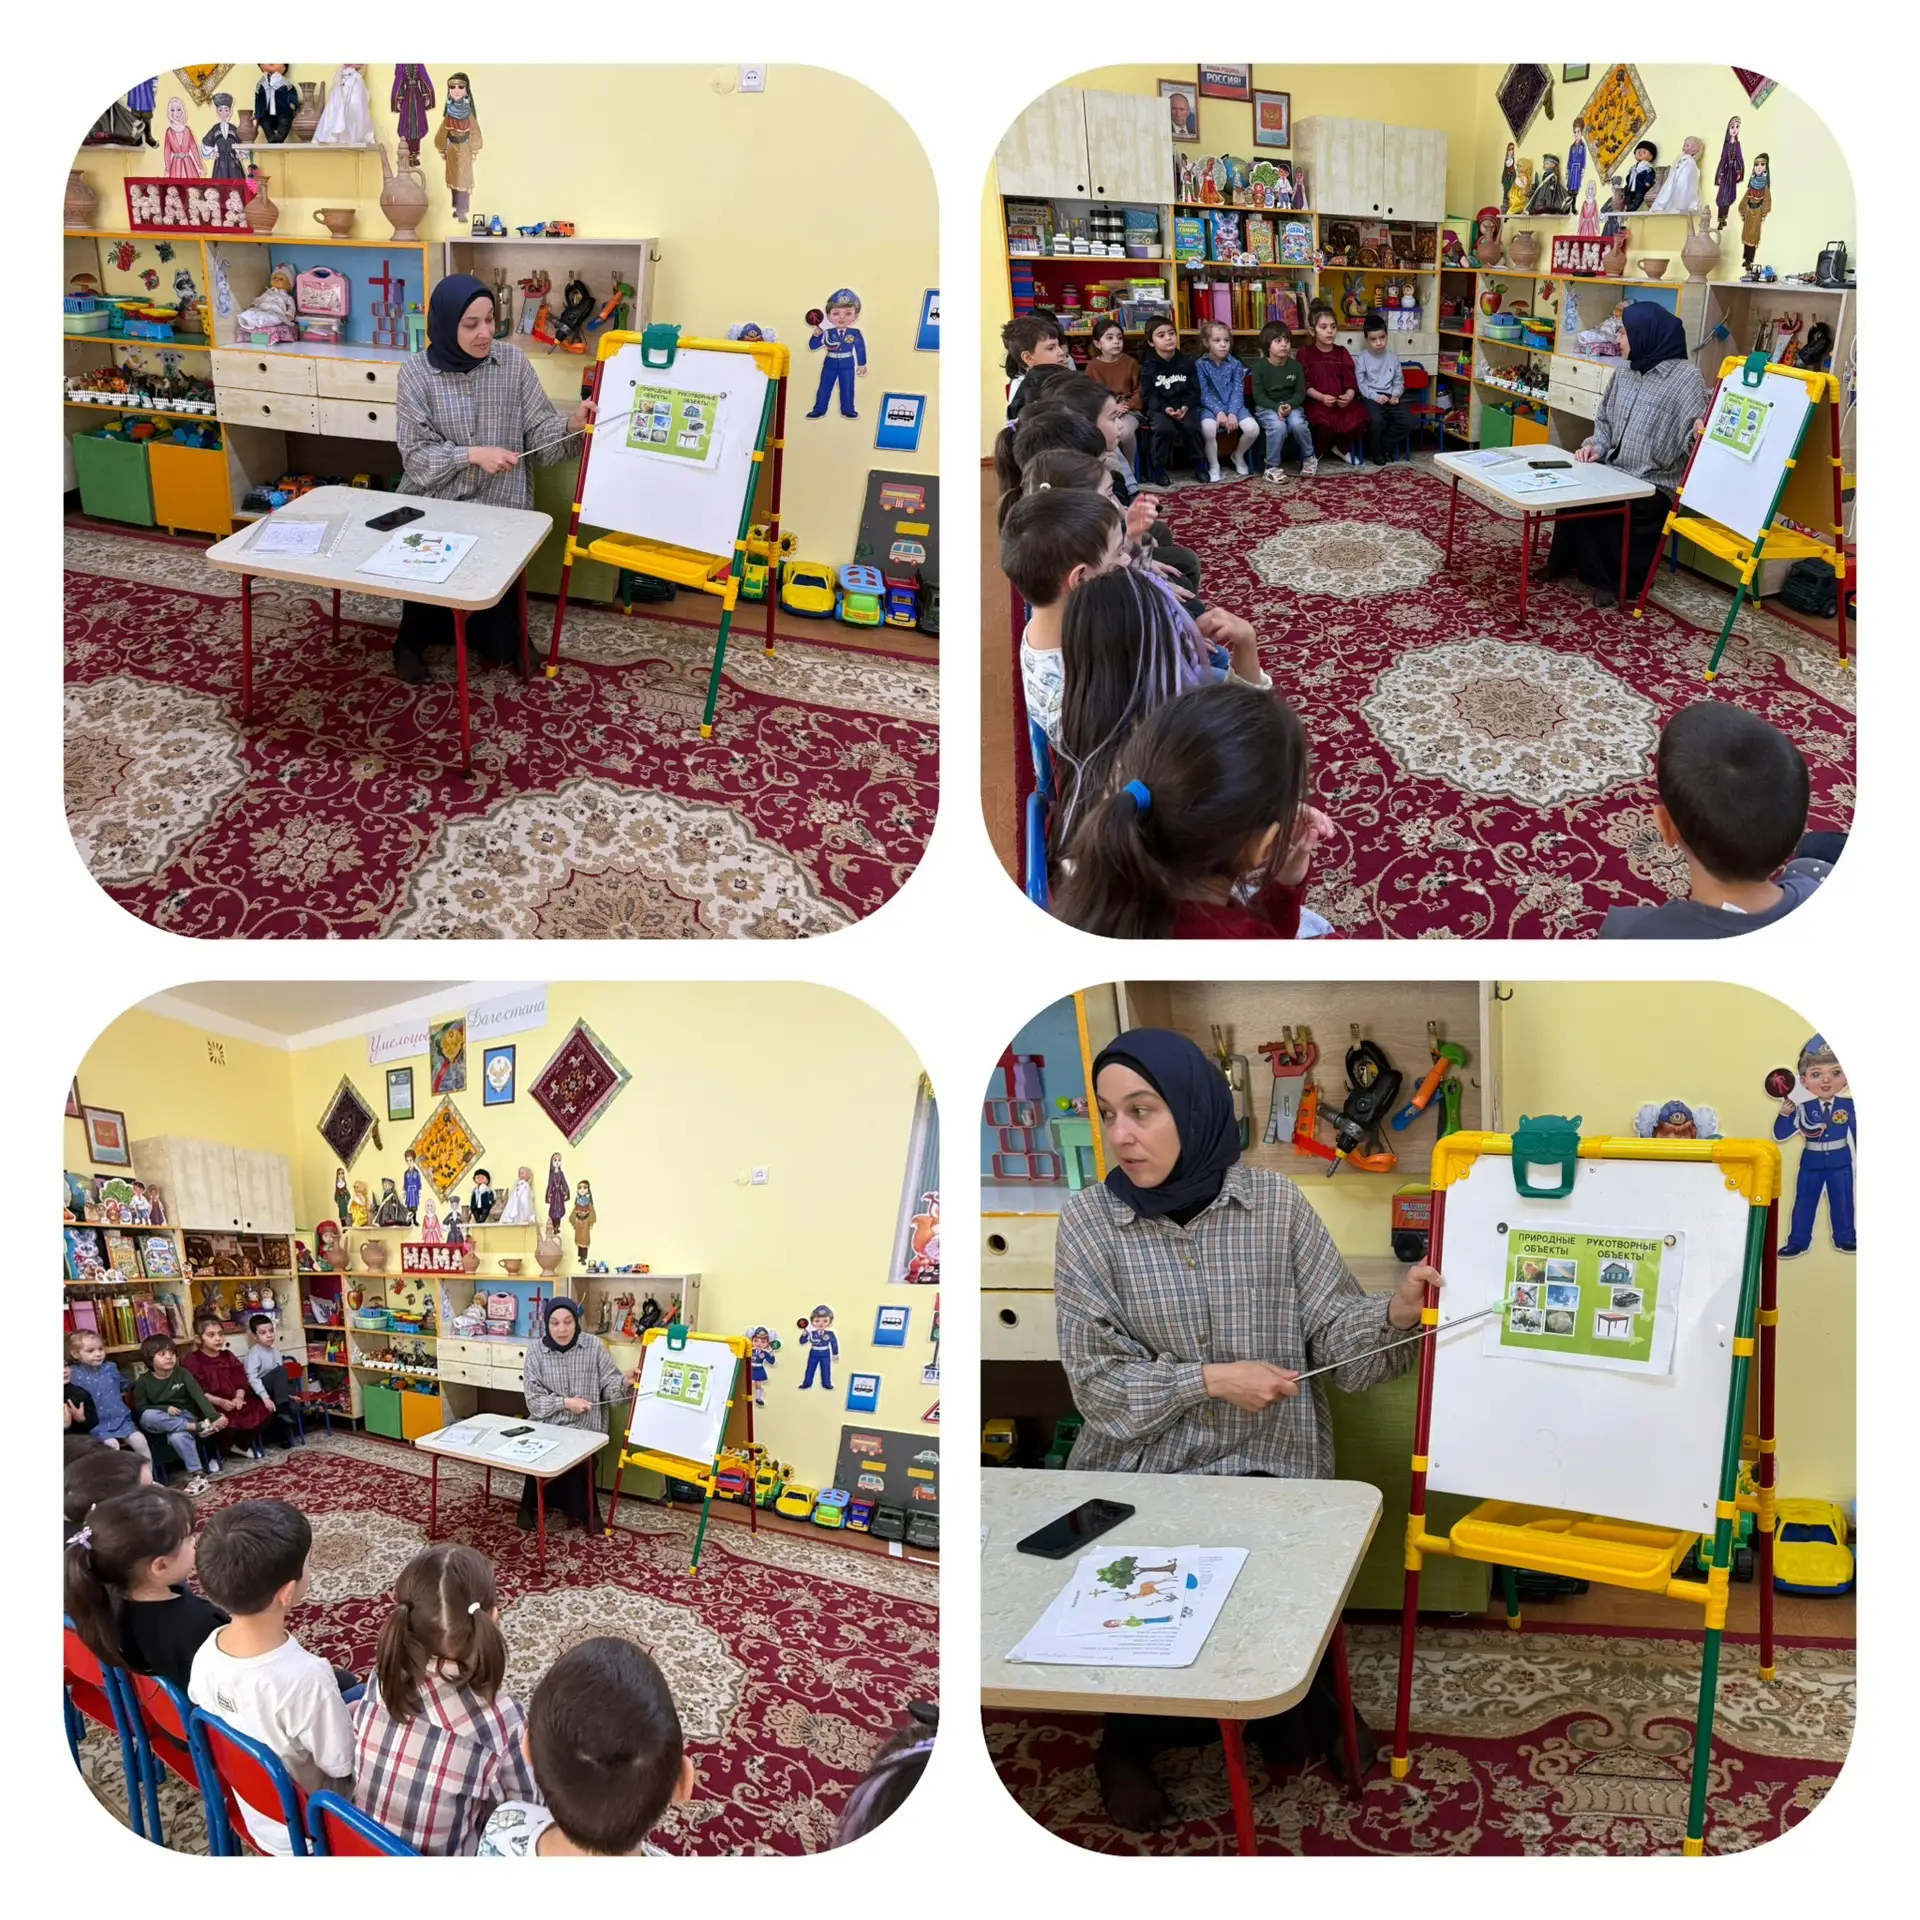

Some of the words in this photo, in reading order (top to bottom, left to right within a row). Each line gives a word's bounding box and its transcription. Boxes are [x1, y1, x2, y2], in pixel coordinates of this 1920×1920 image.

[1206, 72, 1242, 86] РОССИЯ!
[130, 184, 248, 228] МАМА
[1518, 1233, 1576, 1245] ПРИРОДНЫЕ
[1586, 1238, 1657, 1251] РУКОТВОРНЫЕ
[1524, 1244, 1569, 1255] ОБЪЕКТЫ
[1597, 1250, 1645, 1261] ОБЪЕКТЫ
[403, 1246, 464, 1270] МАМА
